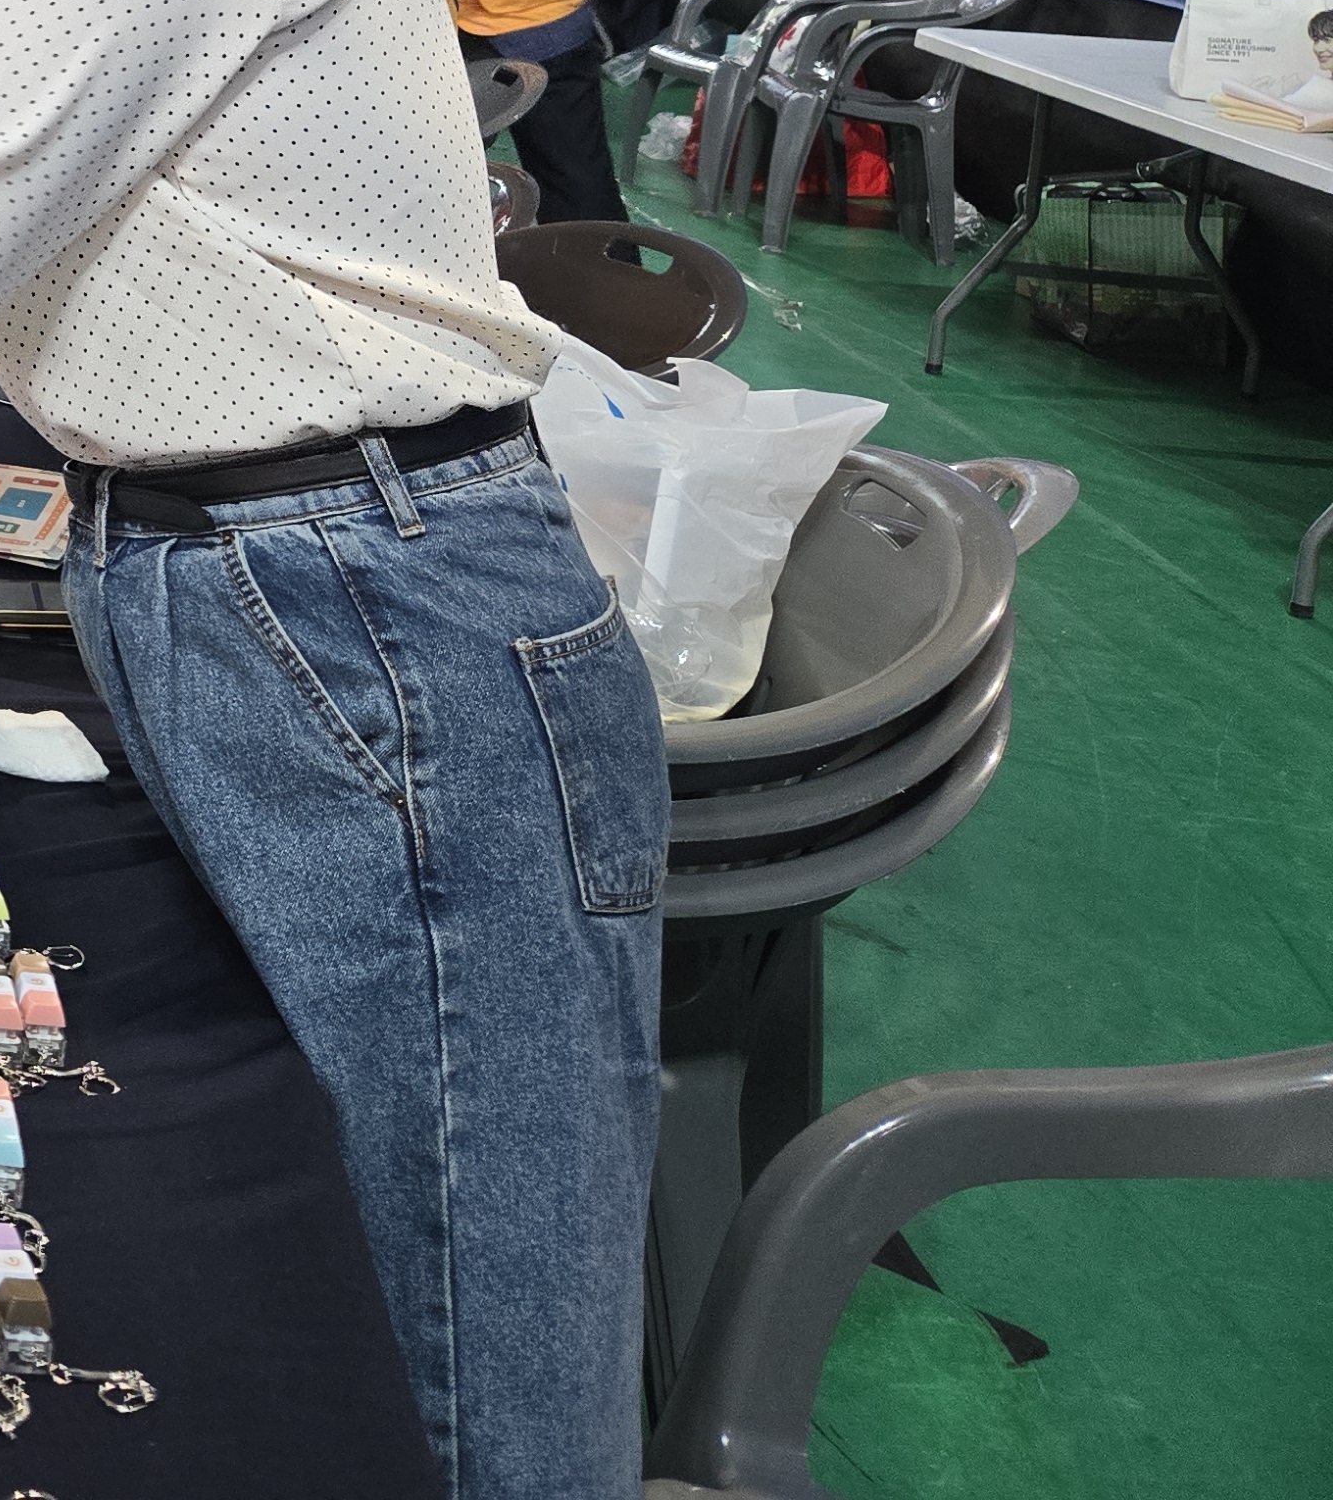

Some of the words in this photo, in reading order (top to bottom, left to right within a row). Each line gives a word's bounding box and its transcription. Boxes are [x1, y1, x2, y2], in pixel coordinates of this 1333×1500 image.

[1207, 36, 1252, 45] SIGNATURE
[1235, 44, 1276, 53] BRUSHING
[1232, 50, 1251, 58] 1991
